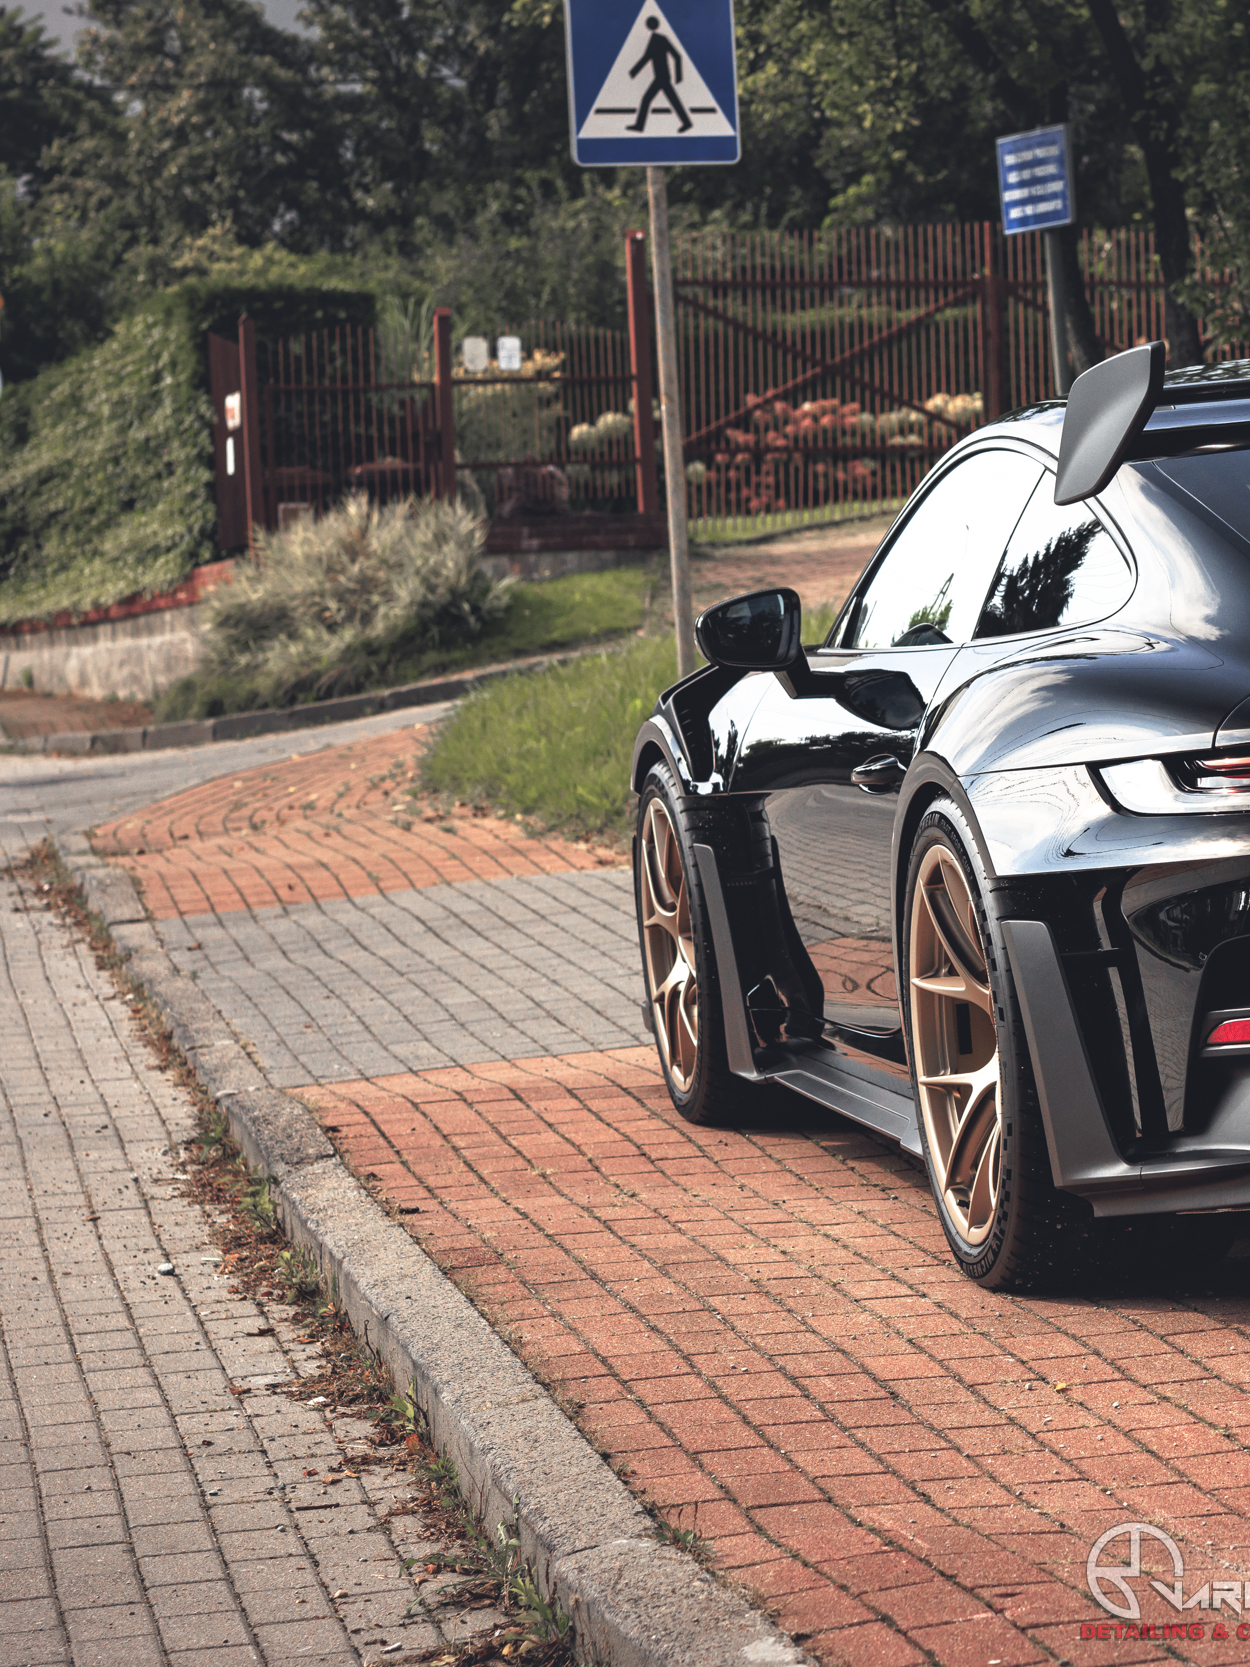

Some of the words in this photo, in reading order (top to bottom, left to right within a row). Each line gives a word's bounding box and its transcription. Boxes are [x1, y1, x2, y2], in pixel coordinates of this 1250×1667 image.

[950, 831, 964, 854] SPORT
[962, 855, 971, 873] CUP
[962, 1248, 995, 1277] MICHELIN
